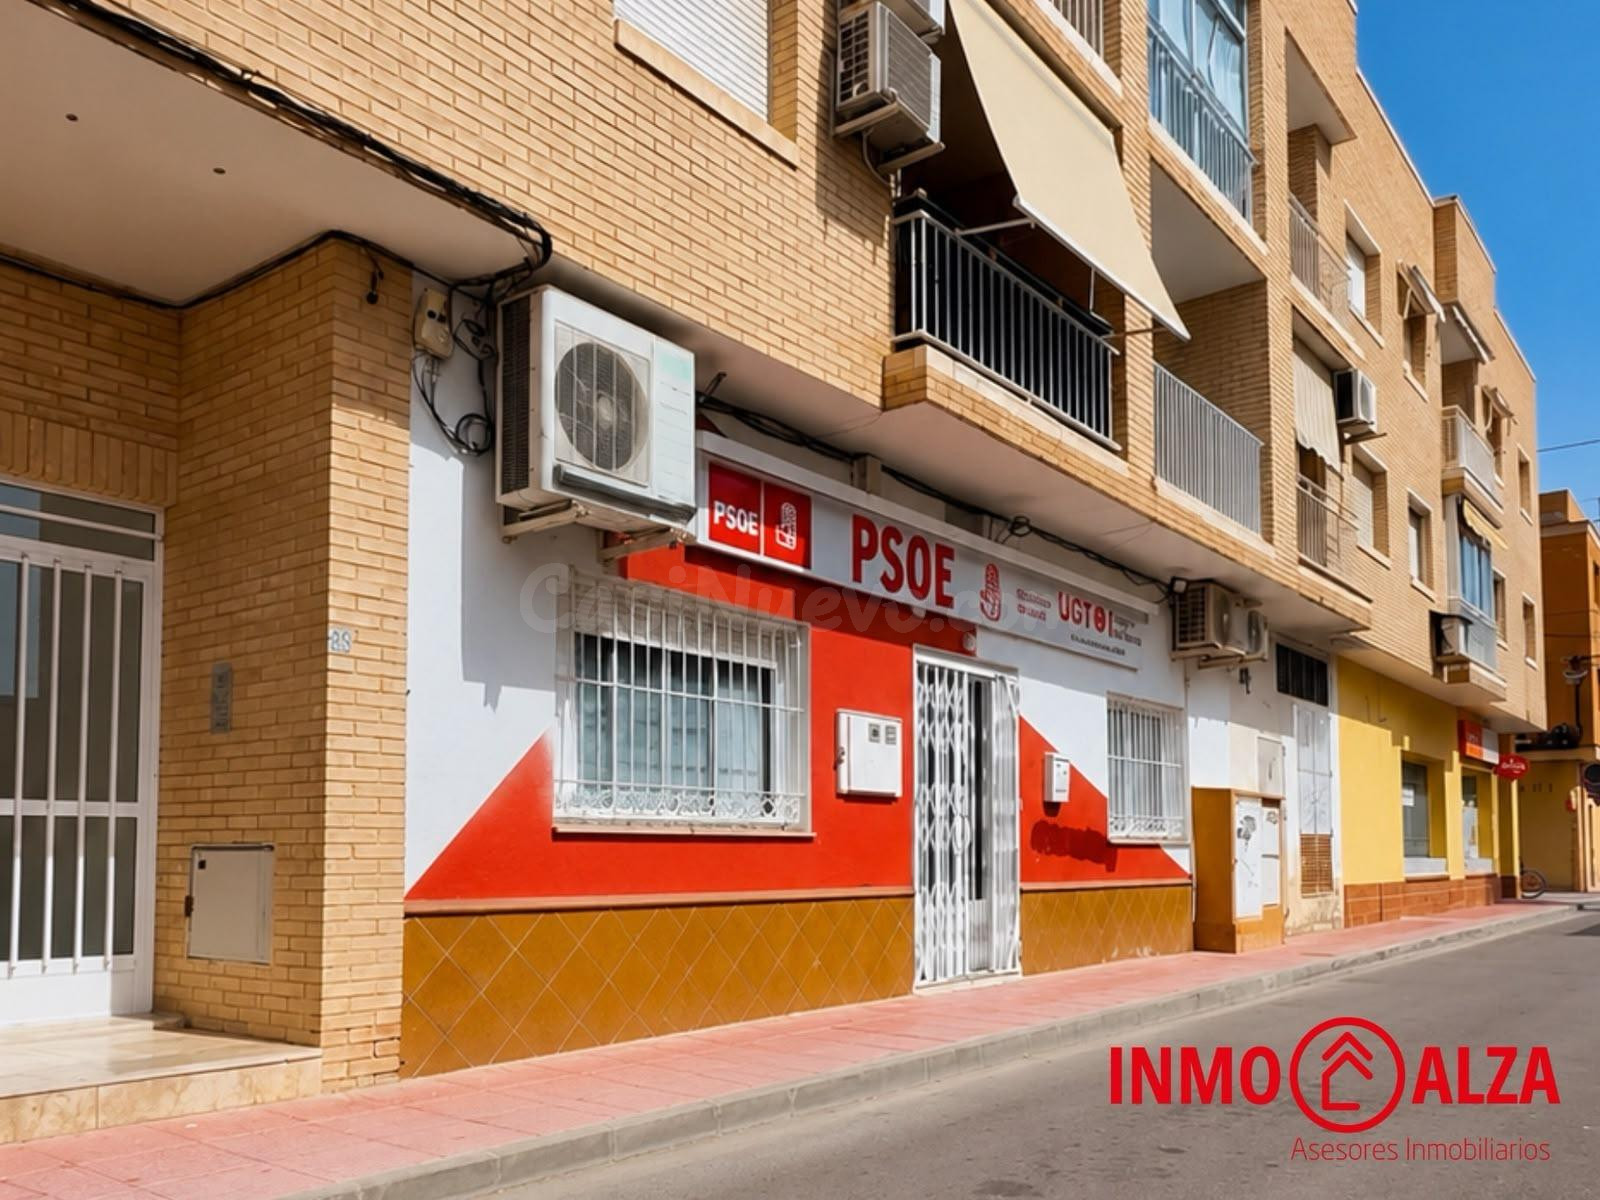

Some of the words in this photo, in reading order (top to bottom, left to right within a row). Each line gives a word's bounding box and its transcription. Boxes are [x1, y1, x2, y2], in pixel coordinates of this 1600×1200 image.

[713, 500, 759, 536] PSOE
[852, 513, 955, 609] PSOE
[1058, 591, 1092, 629] UGT
